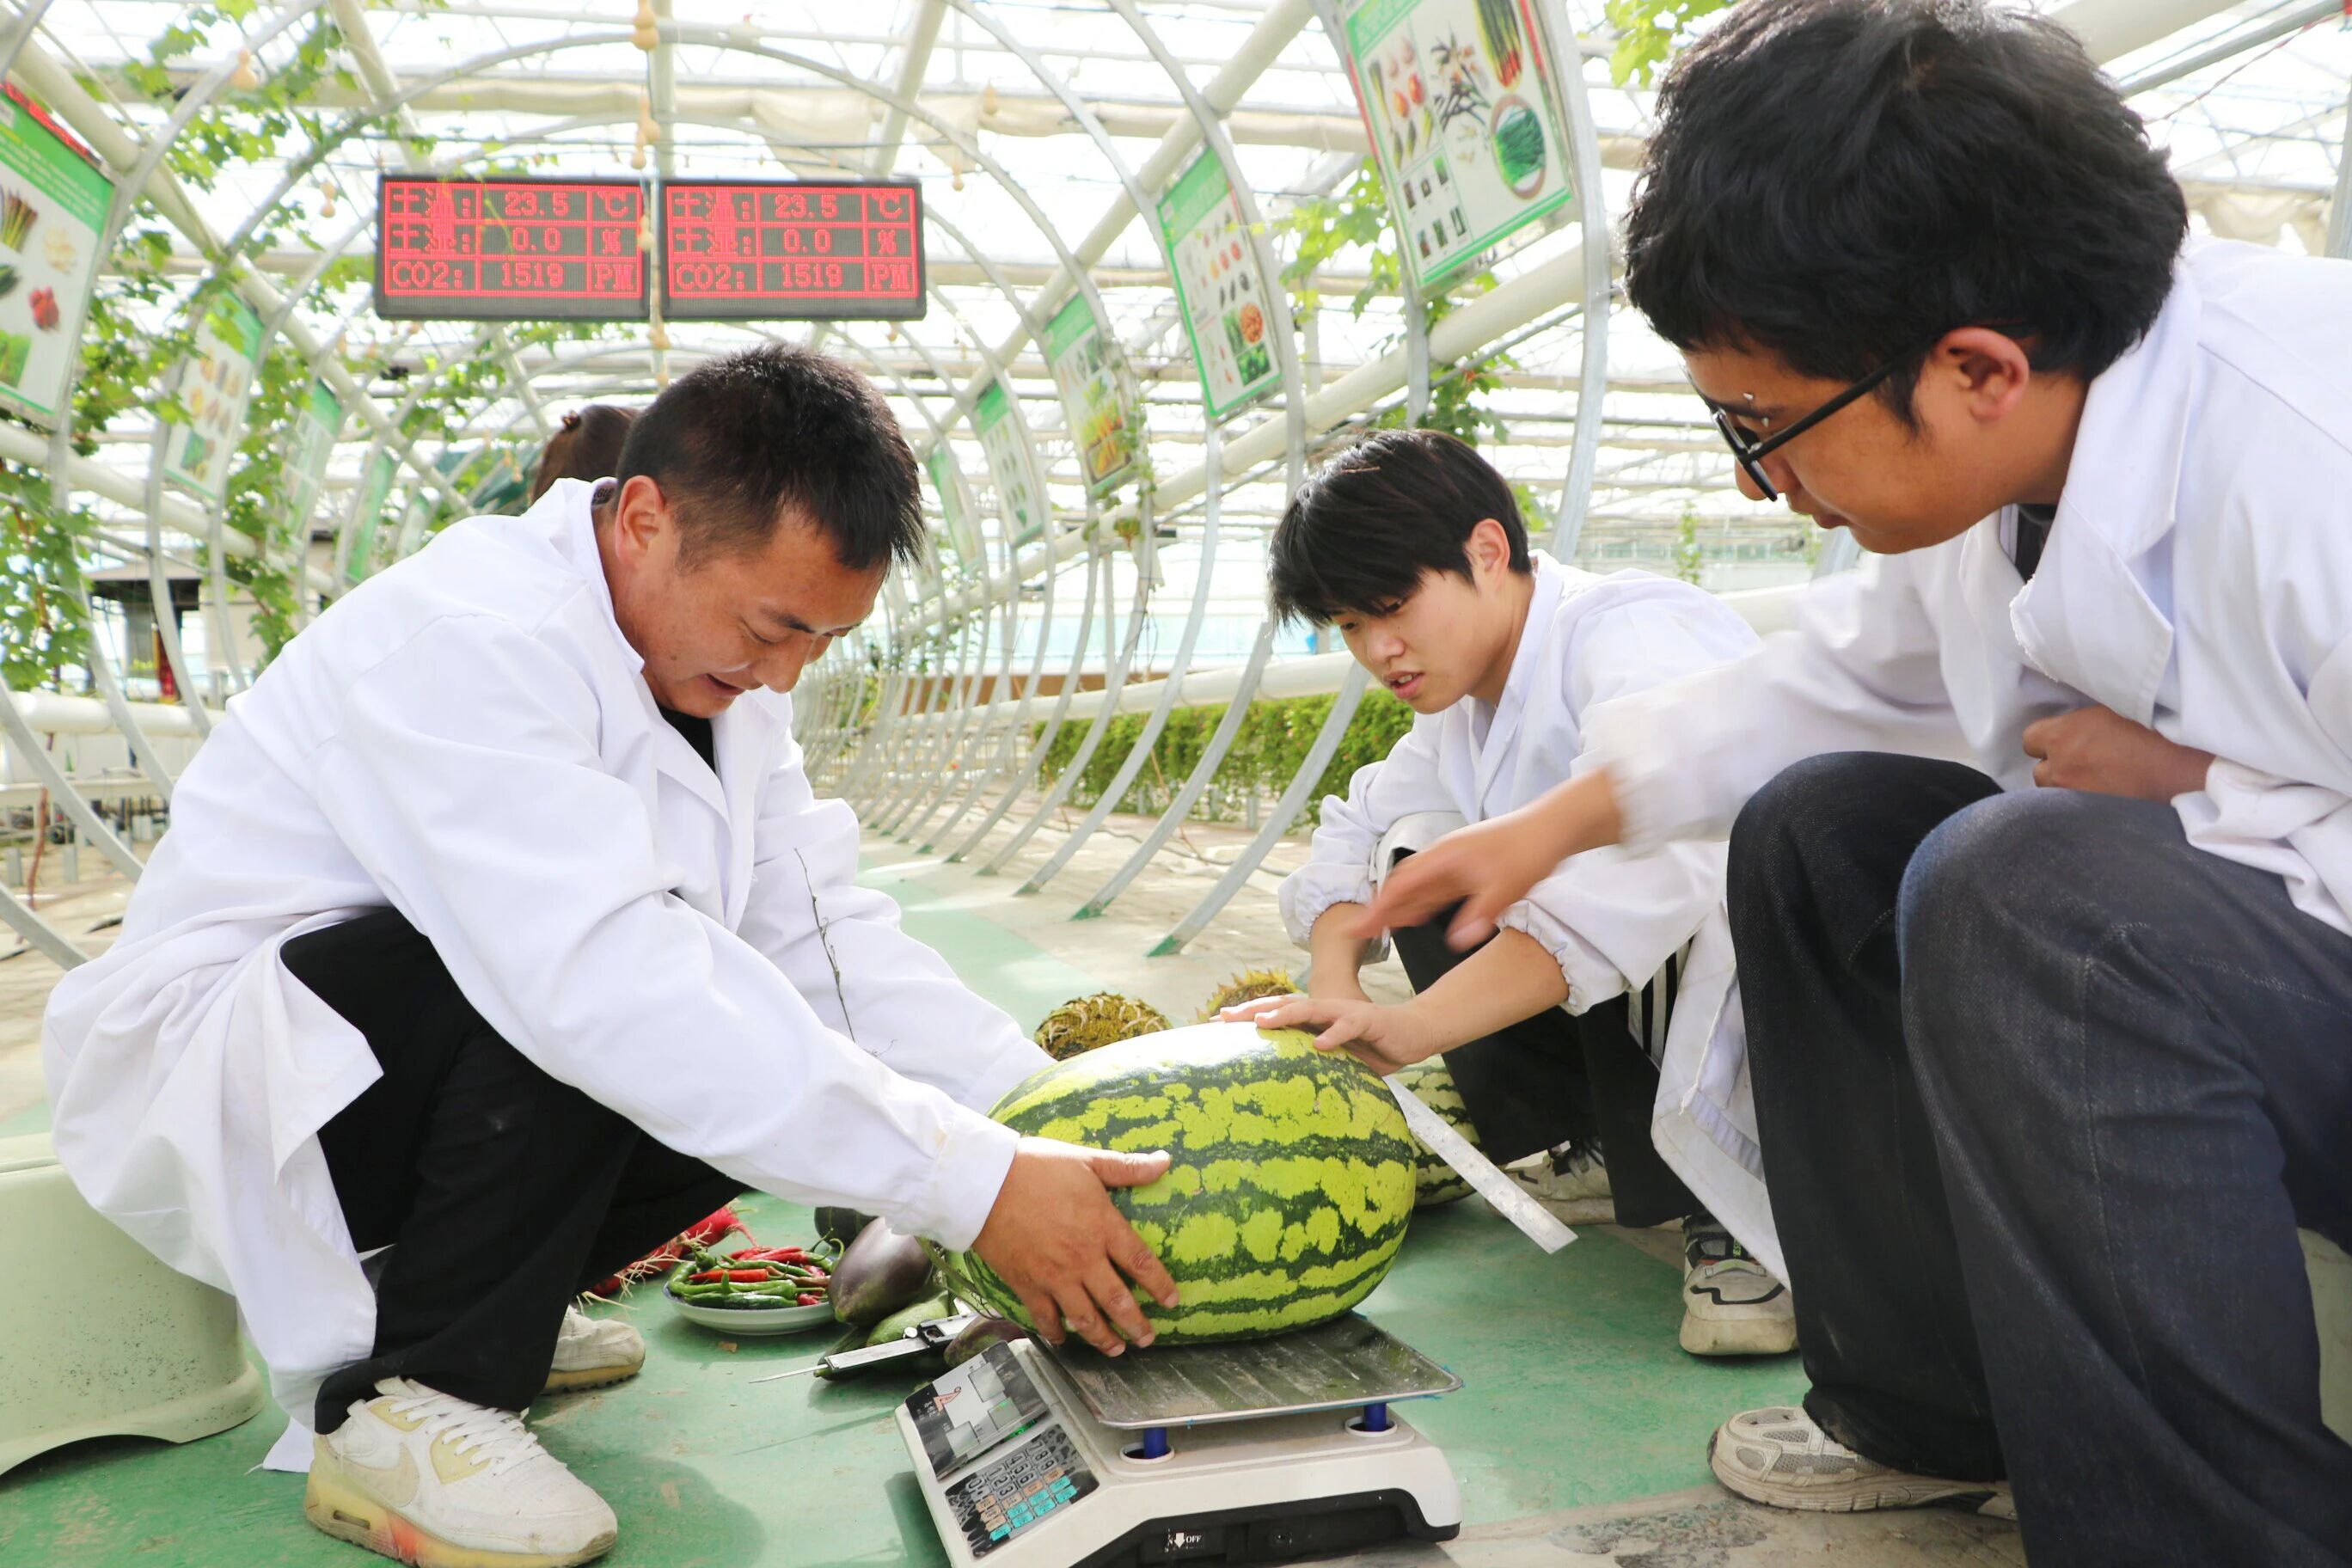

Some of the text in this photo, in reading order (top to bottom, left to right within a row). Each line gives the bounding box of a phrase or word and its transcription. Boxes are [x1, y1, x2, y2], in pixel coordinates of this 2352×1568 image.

[505, 191, 569, 217] 23.5
[775, 193, 839, 218] 23.5
[511, 227, 561, 252] 0.0
[783, 229, 831, 254] 0.0
[393, 260, 463, 288] CO2:
[502, 262, 564, 287] 1519
[677, 263, 746, 291] CO2:
[782, 263, 843, 288] 1519
[1028, 1441, 1043, 1451] 7
[1009, 1455, 1023, 1465] 4
[1035, 1450, 1048, 1461] 8
[1014, 1463, 1028, 1474] 5
[1041, 1460, 1055, 1470] 9
[989, 1467, 1002, 1476] 1
[968, 1478, 983, 1489] 0
[994, 1475, 1008, 1486] 2
[1020, 1473, 1034, 1484] 6
[1000, 1485, 1014, 1497] 3
[1185, 1534, 1202, 1544] OFF
